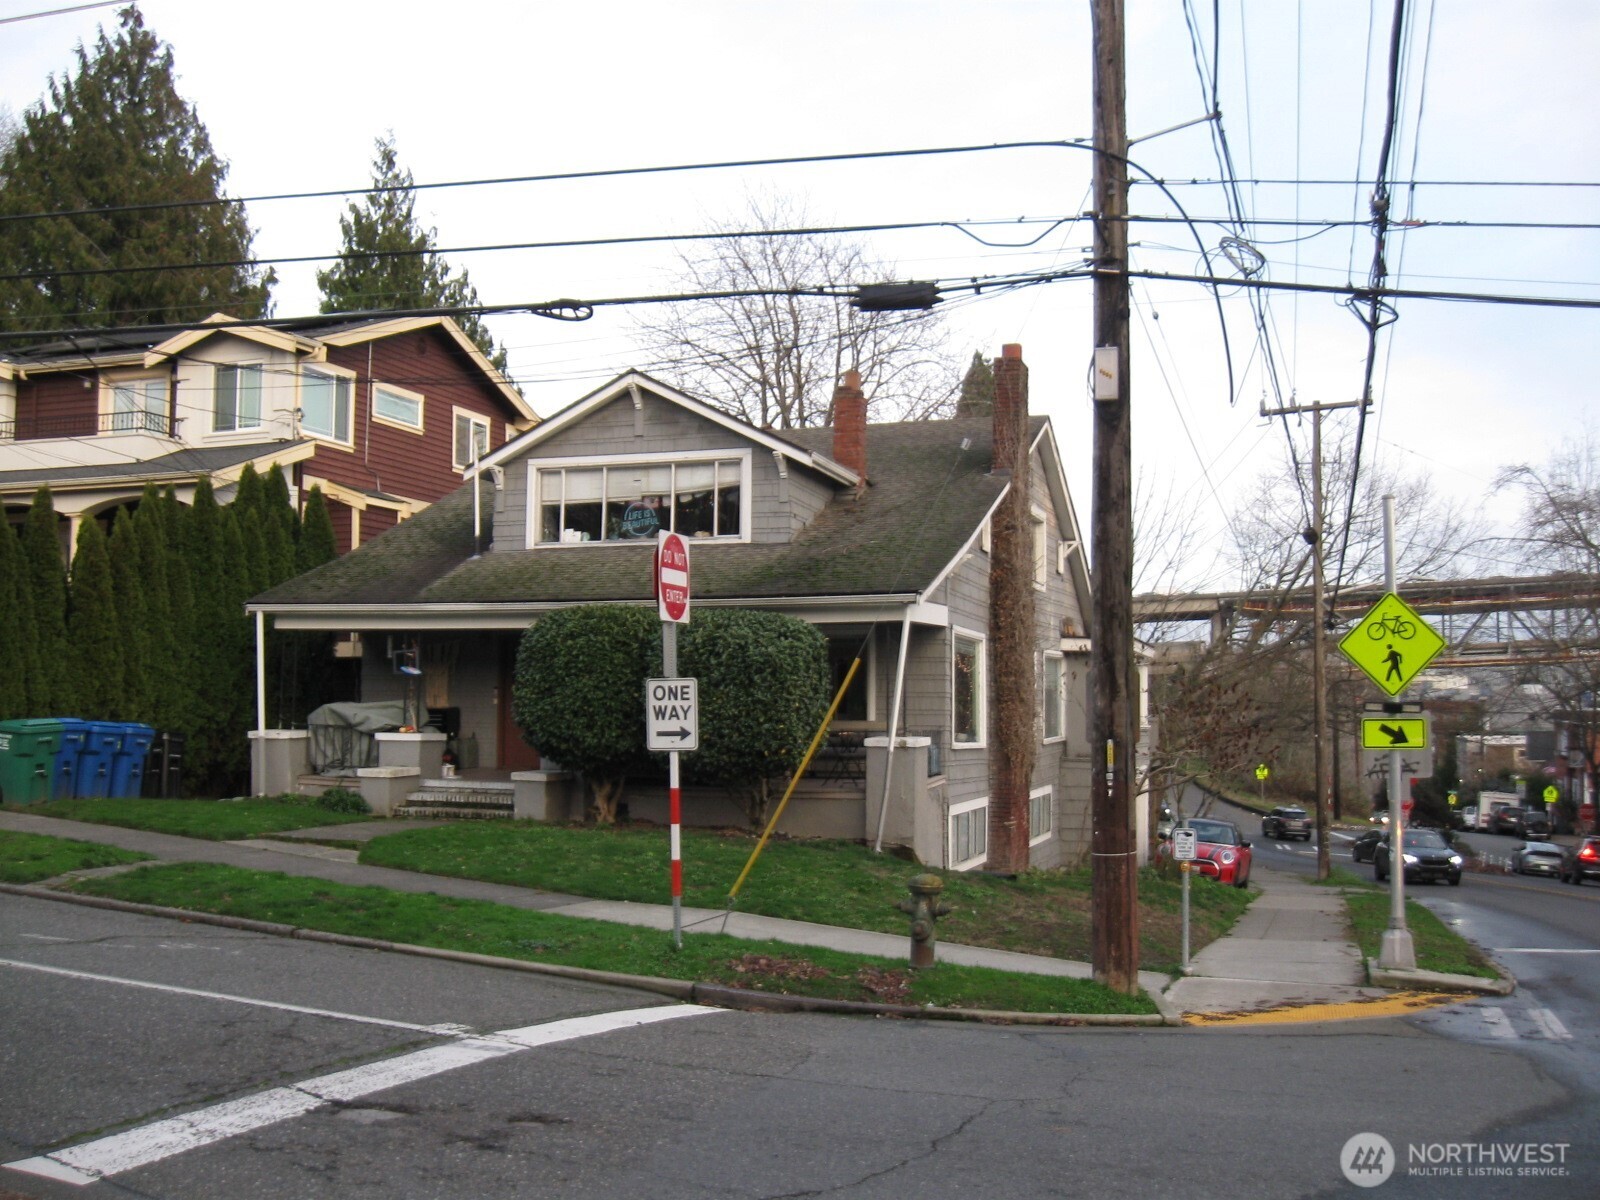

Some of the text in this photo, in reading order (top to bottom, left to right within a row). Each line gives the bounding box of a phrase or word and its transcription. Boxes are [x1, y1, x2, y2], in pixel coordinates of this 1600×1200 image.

[628, 509, 651, 520] LIFE IS
[622, 517, 660, 530] BEAUTIFUL
[663, 549, 685, 567] DO NOT
[665, 588, 684, 604] ENTER
[653, 684, 690, 701] ONE
[652, 704, 692, 721] WAY
